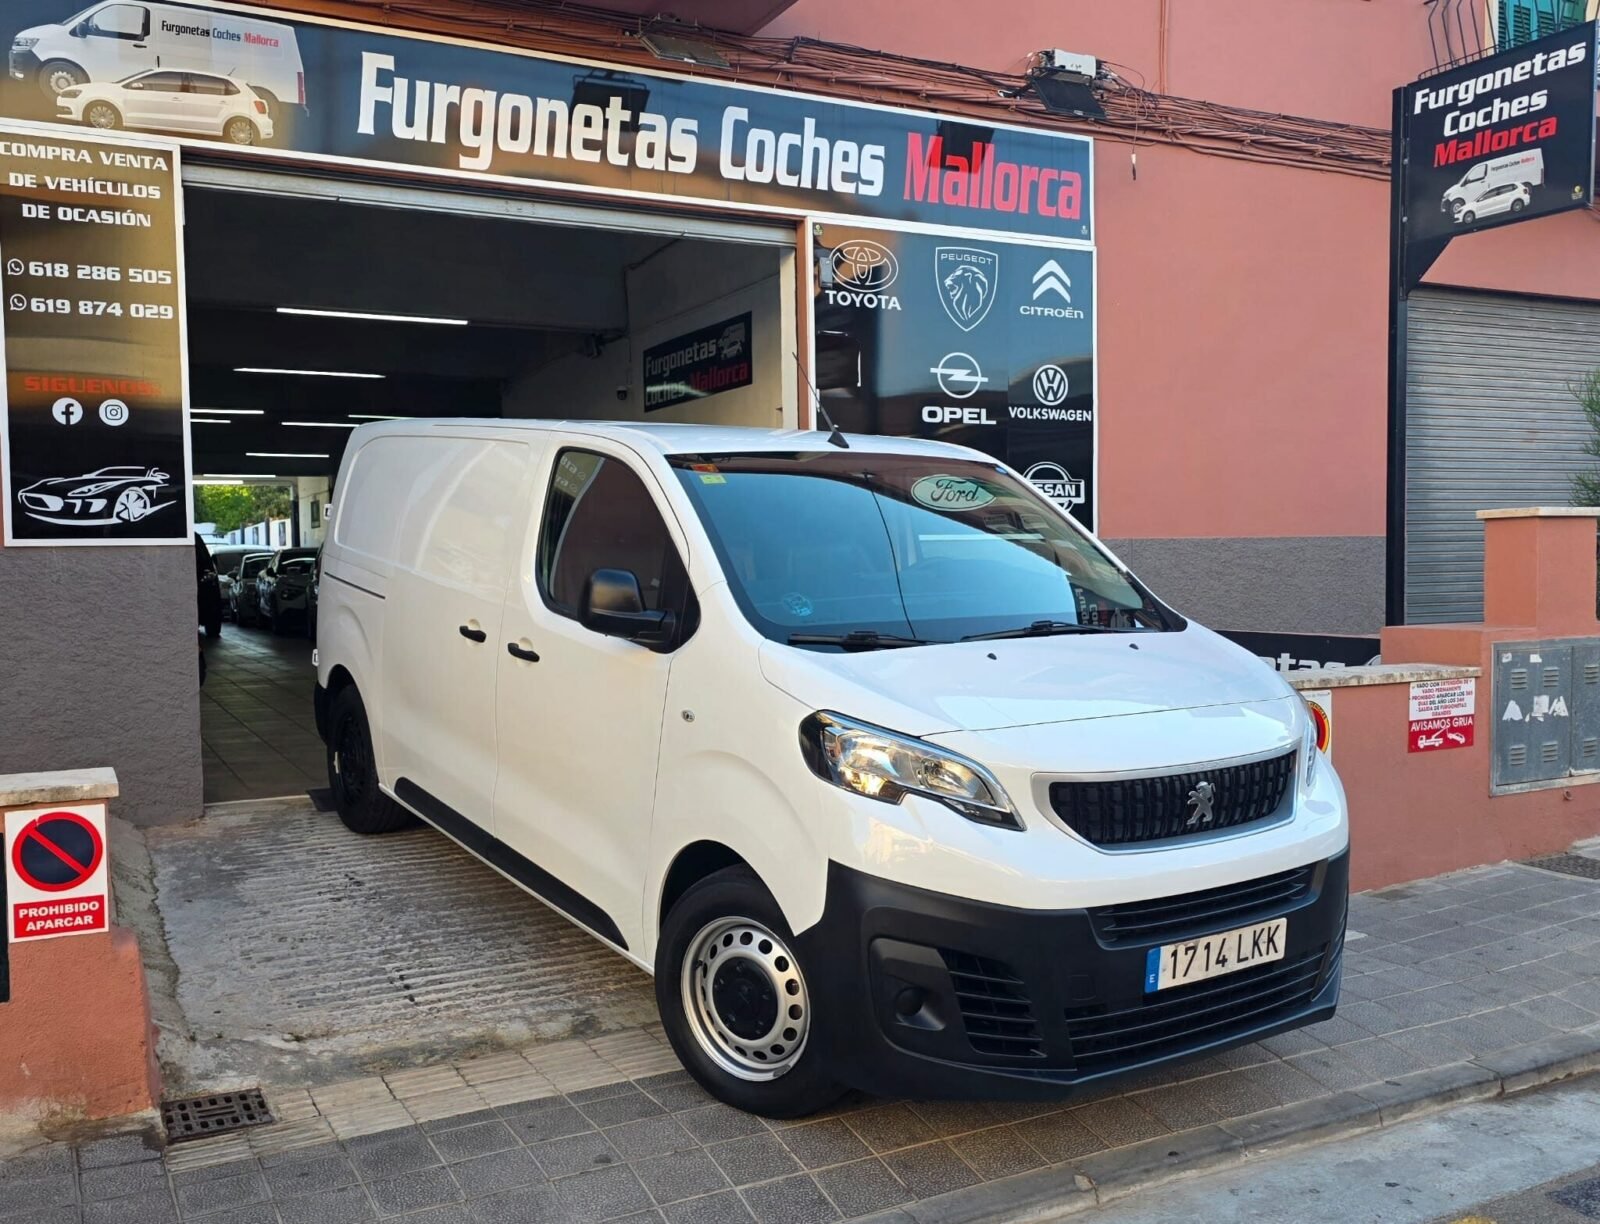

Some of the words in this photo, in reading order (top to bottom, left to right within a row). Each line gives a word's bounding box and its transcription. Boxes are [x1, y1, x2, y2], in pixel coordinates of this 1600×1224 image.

[161, 20, 210, 37] Furgonetas
[212, 27, 241, 42] Coches
[243, 31, 279, 47] Mallorca
[1414, 41, 1587, 115] Furgonetas
[1443, 89, 1548, 137] Coches
[356, 51, 699, 174] Furgonetas
[719, 105, 886, 197] Coches
[903, 131, 1082, 220] Mallorca
[1433, 116, 1558, 168] Mallorca
[0, 141, 93, 163] COMPRA
[99, 151, 169, 171] VENTA
[9, 172, 37, 188] DE
[44, 177, 161, 199] VEHÍCULOS
[22, 203, 50, 219] DE
[58, 209, 152, 227] OCASIÓN
[940, 253, 993, 266] PEUGEOT
[28, 261, 70, 278] 618
[77, 264, 121, 281] 286
[128, 268, 172, 285] 505
[31, 298, 71, 314] 619
[78, 300, 123, 317] 874
[130, 303, 174, 320] 029
[825, 289, 902, 311] TOYOTA
[645, 337, 717, 378] Furgonetas
[689, 362, 748, 391] Mallorca
[921, 405, 997, 425] OPEL
[1008, 406, 1092, 422] VOLKSWAGEN
[930, 479, 979, 502] Ford
[1411, 718, 1451, 732] AVISAMOS
[1452, 716, 1473, 727] GRUA
[18, 901, 100, 918] PROHIBIDO
[26, 915, 94, 932] APARCAR
[1170, 937, 1228, 980] 1714
[1236, 924, 1281, 964] LKK
